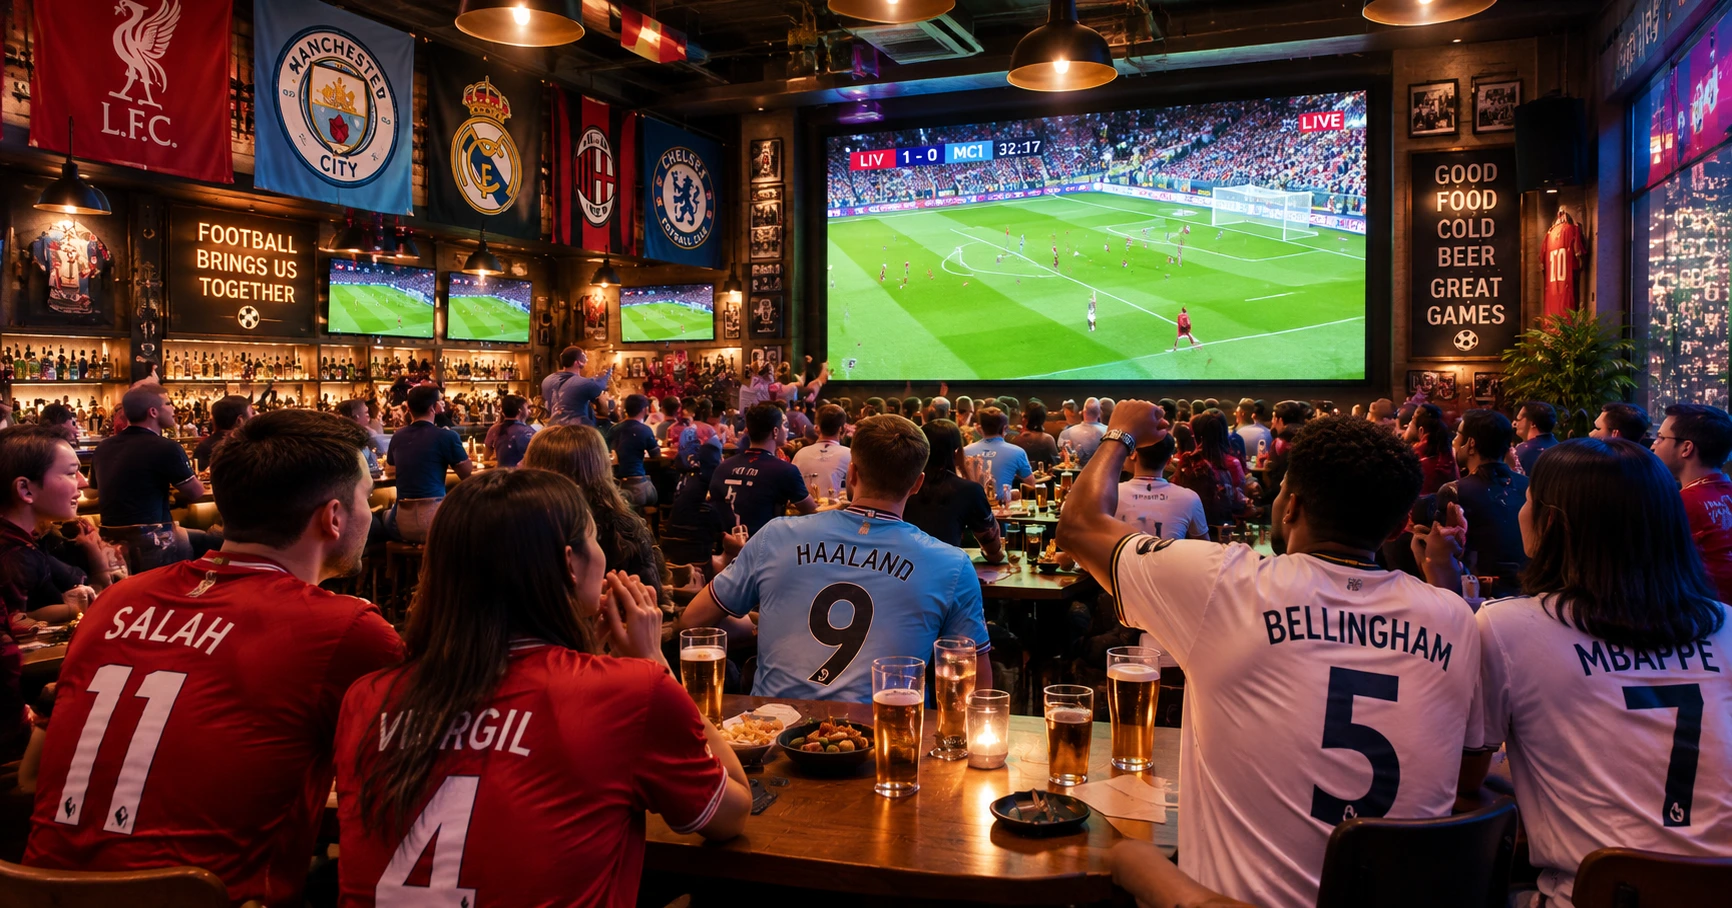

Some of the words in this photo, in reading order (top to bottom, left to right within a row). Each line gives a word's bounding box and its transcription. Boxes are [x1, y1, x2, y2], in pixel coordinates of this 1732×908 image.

[101, 101, 178, 149] L.F.C.
[1302, 113, 1341, 130] LIVE
[320, 155, 358, 177] CITY
[860, 153, 884, 166] LIV
[903, 151, 910, 163] 1
[928, 149, 938, 161] 0
[999, 140, 1041, 156] 32:17
[1435, 162, 1498, 185] GOOD
[1436, 189, 1498, 212] FOOD
[198, 222, 298, 254] FOOTBALL
[1437, 217, 1496, 239] COLD
[197, 248, 268, 276] BRINGS
[274, 259, 298, 279] US
[1438, 245, 1496, 268] BEER
[1549, 247, 1567, 283] 10
[198, 277, 296, 303] TOGETHER
[1430, 277, 1503, 299] GREAT
[1427, 304, 1506, 326] GAMES
[796, 541, 915, 583] HAALAND
[104, 606, 235, 655] SALAH
[807, 581, 875, 687] 9
[1263, 605, 1453, 672] BELLINGHAM
[1573, 640, 1721, 677] MBAPPE
[54, 664, 188, 835] 11
[1310, 666, 1401, 826] 5
[1622, 683, 1705, 827] 7
[375, 774, 481, 908] 4
